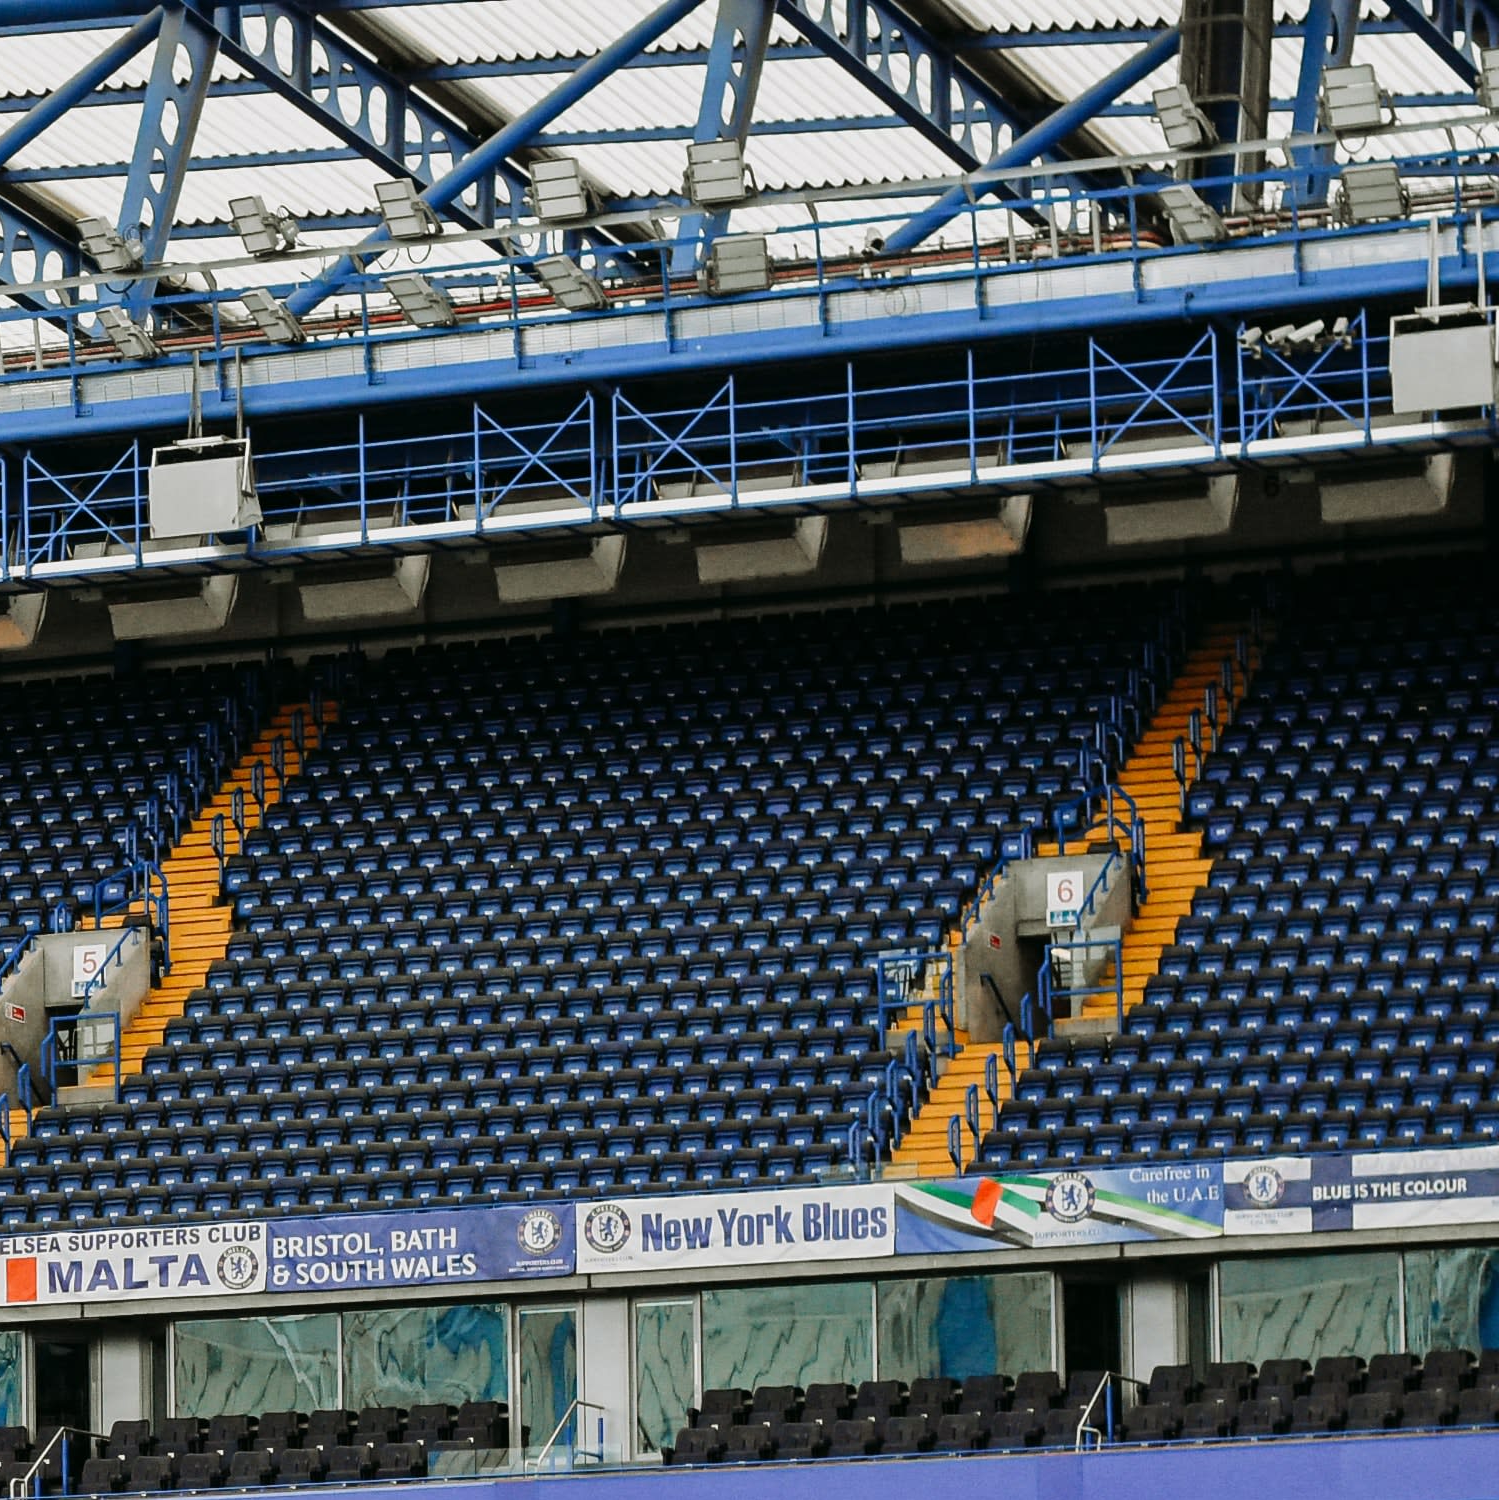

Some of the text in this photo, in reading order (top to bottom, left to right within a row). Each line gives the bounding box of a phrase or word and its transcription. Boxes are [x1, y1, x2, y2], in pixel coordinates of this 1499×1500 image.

[1057, 879, 1074, 903] 6
[82, 951, 97, 974] 5
[1128, 1165, 1211, 1183] Carefree in
[1146, 1185, 1220, 1204] the U.A.E
[1312, 1177, 1468, 1201] BLUE IS THE COLOUR
[68, 1227, 201, 1251] SUPPORTERS
[207, 1224, 262, 1244] CLUB
[641, 1201, 888, 1253] New York Blues
[272, 1227, 458, 1259] BRISTOL, BATH
[46, 1254, 211, 1294] MALTA
[272, 1253, 478, 1286] & SOUTH WALES
